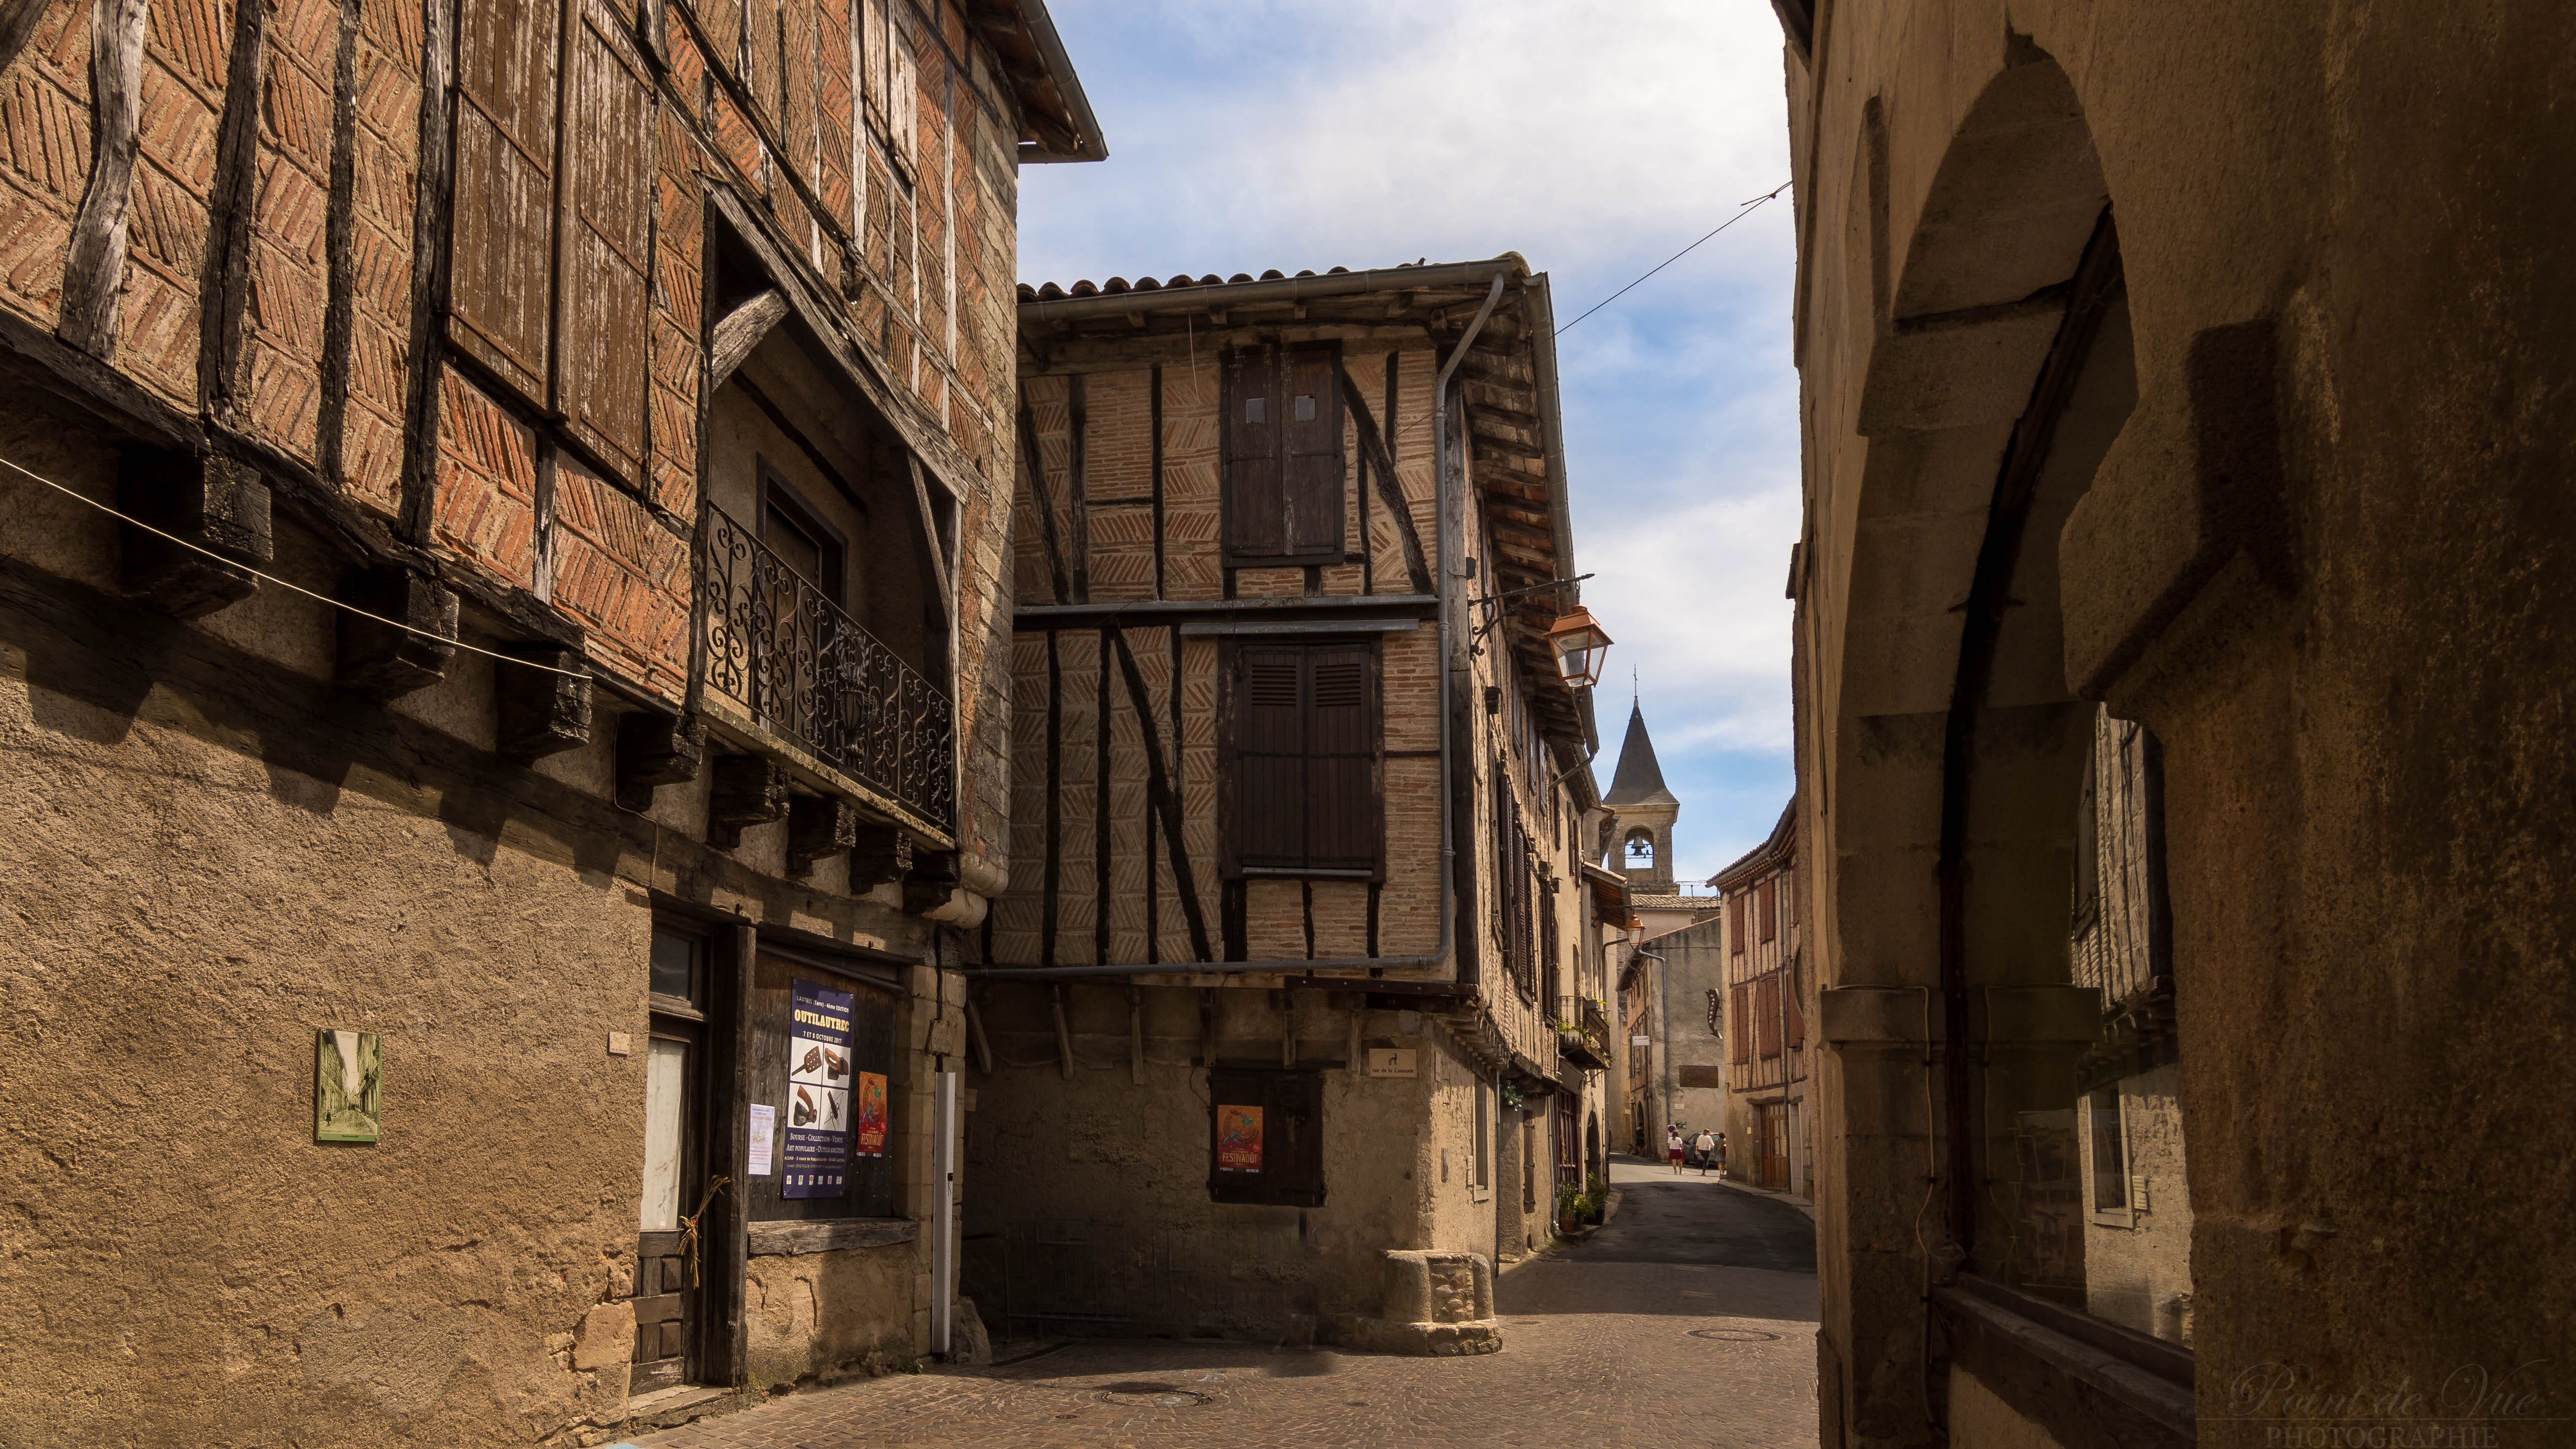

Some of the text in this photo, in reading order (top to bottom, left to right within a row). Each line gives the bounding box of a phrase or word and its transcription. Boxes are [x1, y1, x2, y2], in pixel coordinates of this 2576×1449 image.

[796, 995, 812, 1004] LAUTREC
[813, 1000, 824, 1008] (Tarn)
[794, 1009, 849, 1032] OUTILAUTREC
[816, 1033, 833, 1042] OCTOBRE
[1223, 1152, 1258, 1163] FESTIVAOÛT
